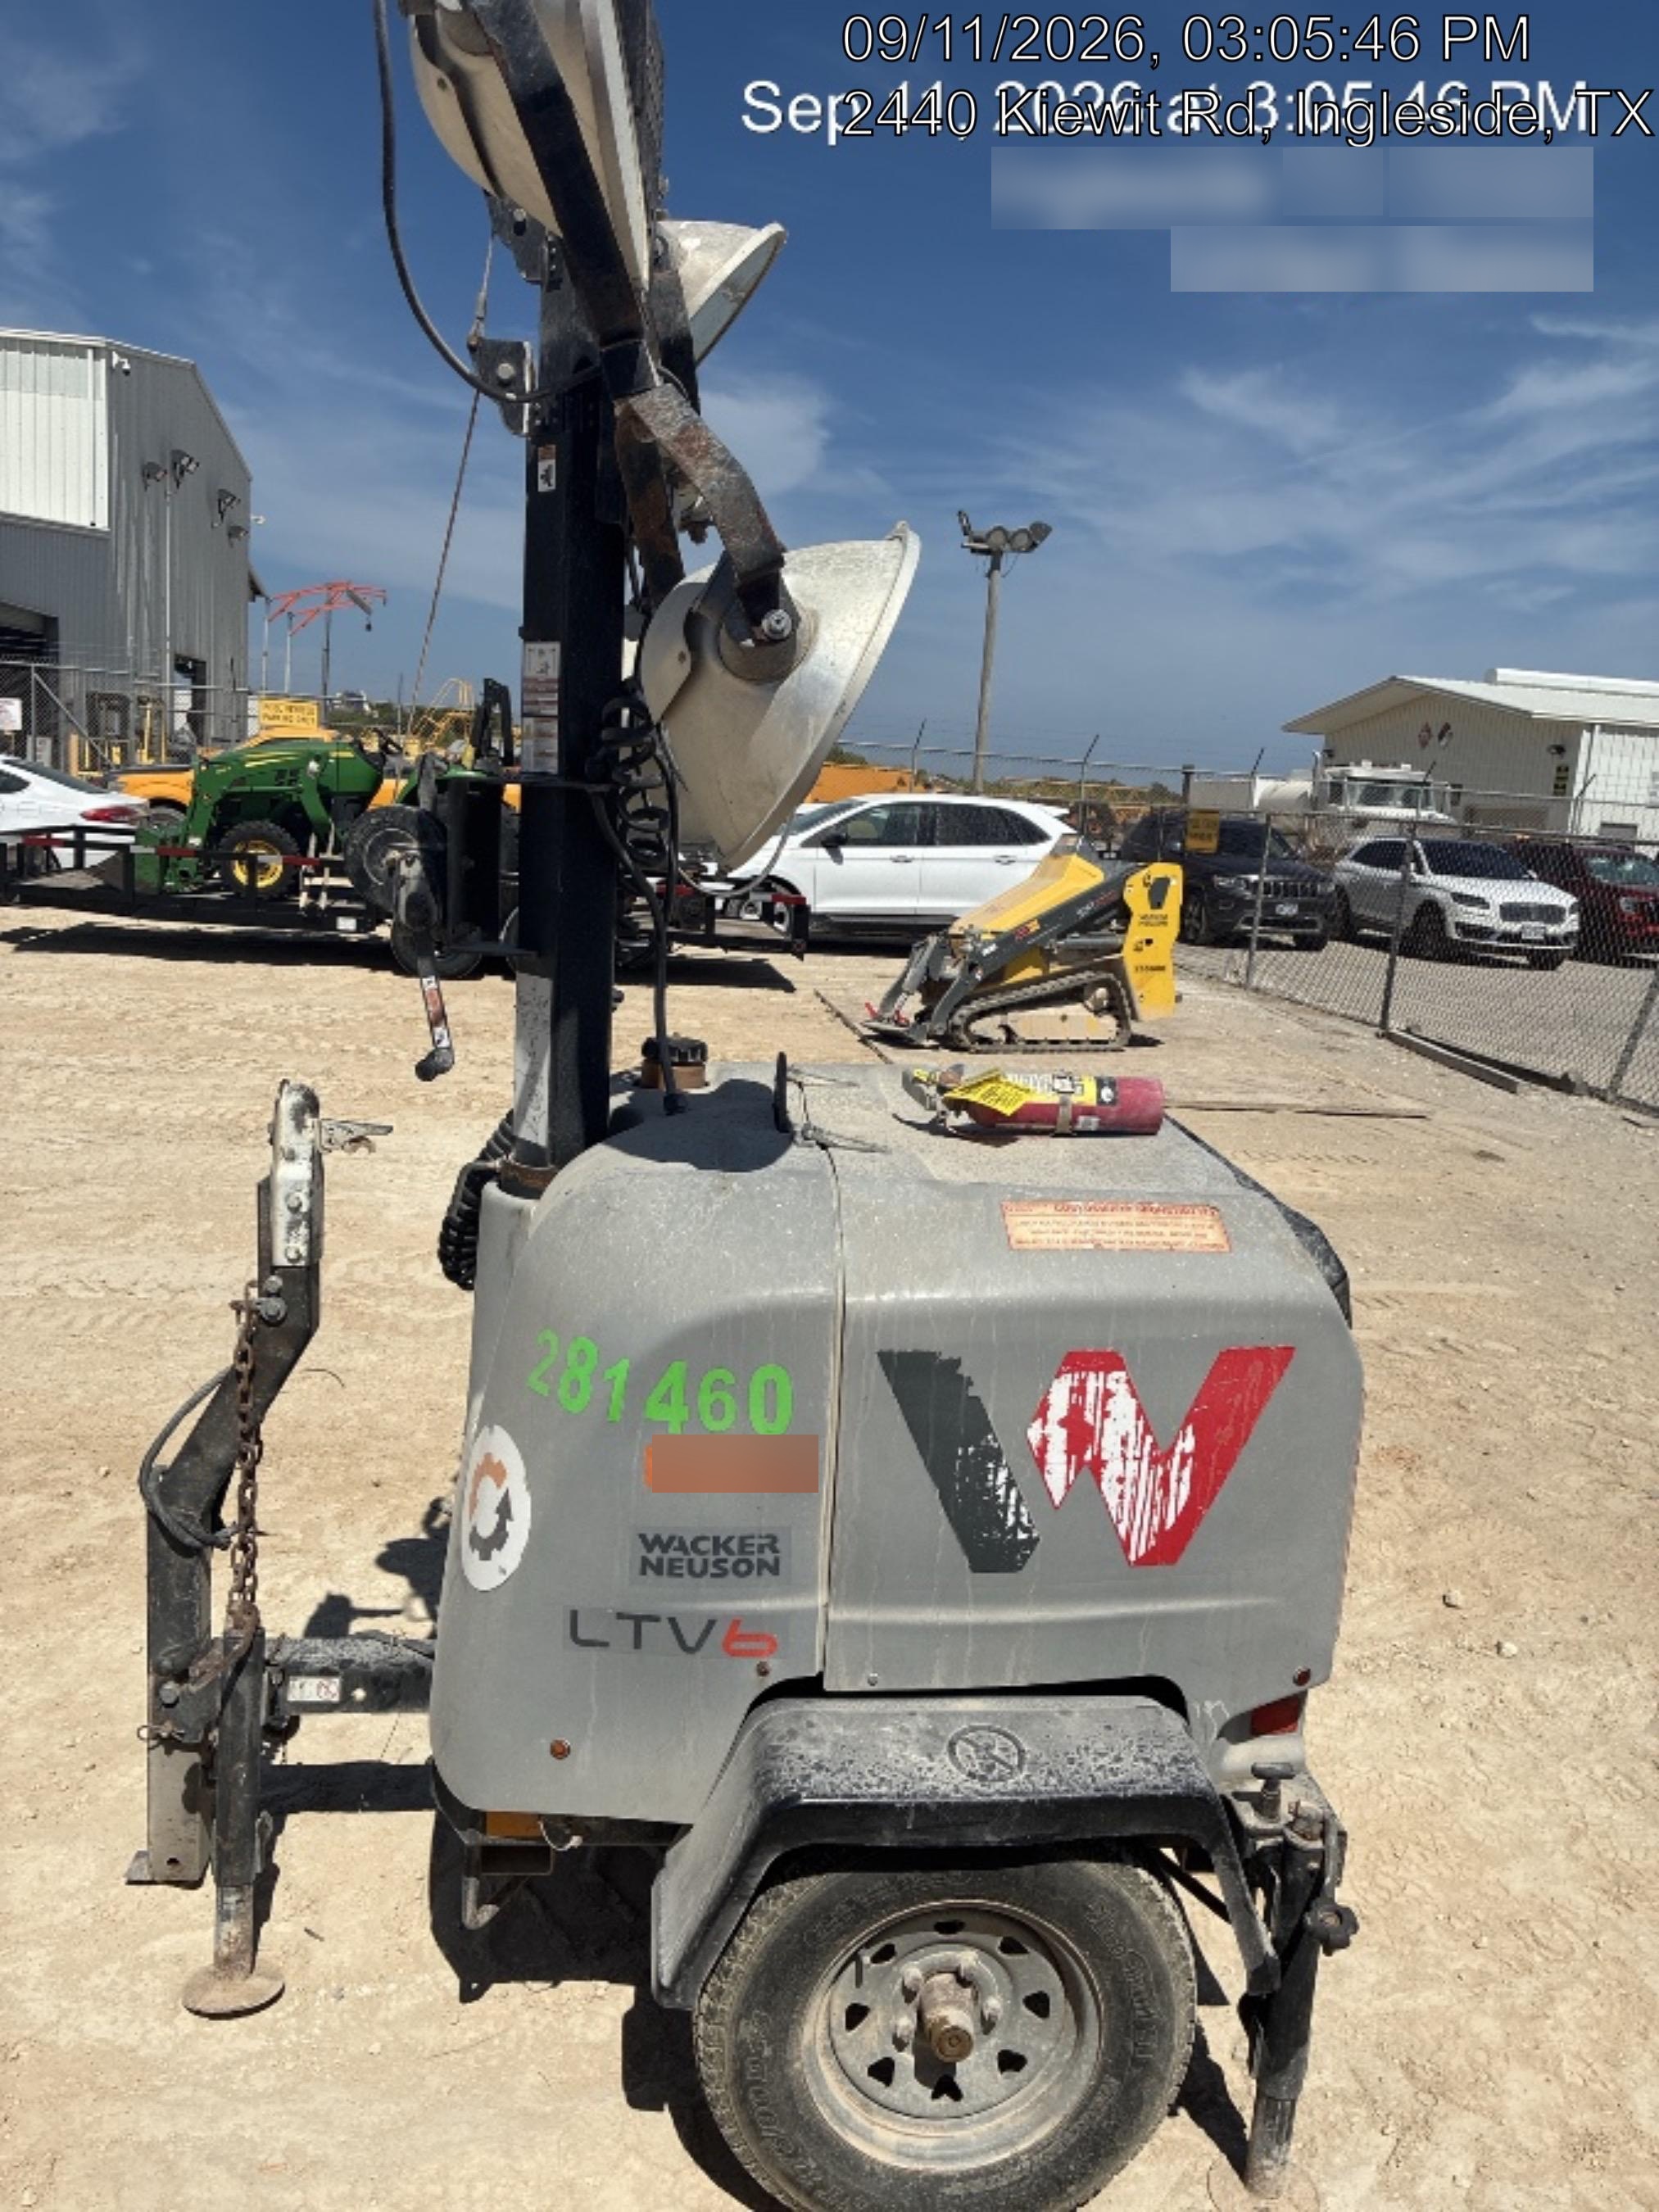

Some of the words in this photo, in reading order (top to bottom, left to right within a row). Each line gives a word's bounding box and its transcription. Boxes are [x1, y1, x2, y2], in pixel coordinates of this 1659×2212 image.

[526, 1328, 794, 1435] 281460
[637, 1533, 781, 1555] WACKER
[639, 1556, 781, 1579] NEUSON
[569, 1609, 778, 1658] LTV6
